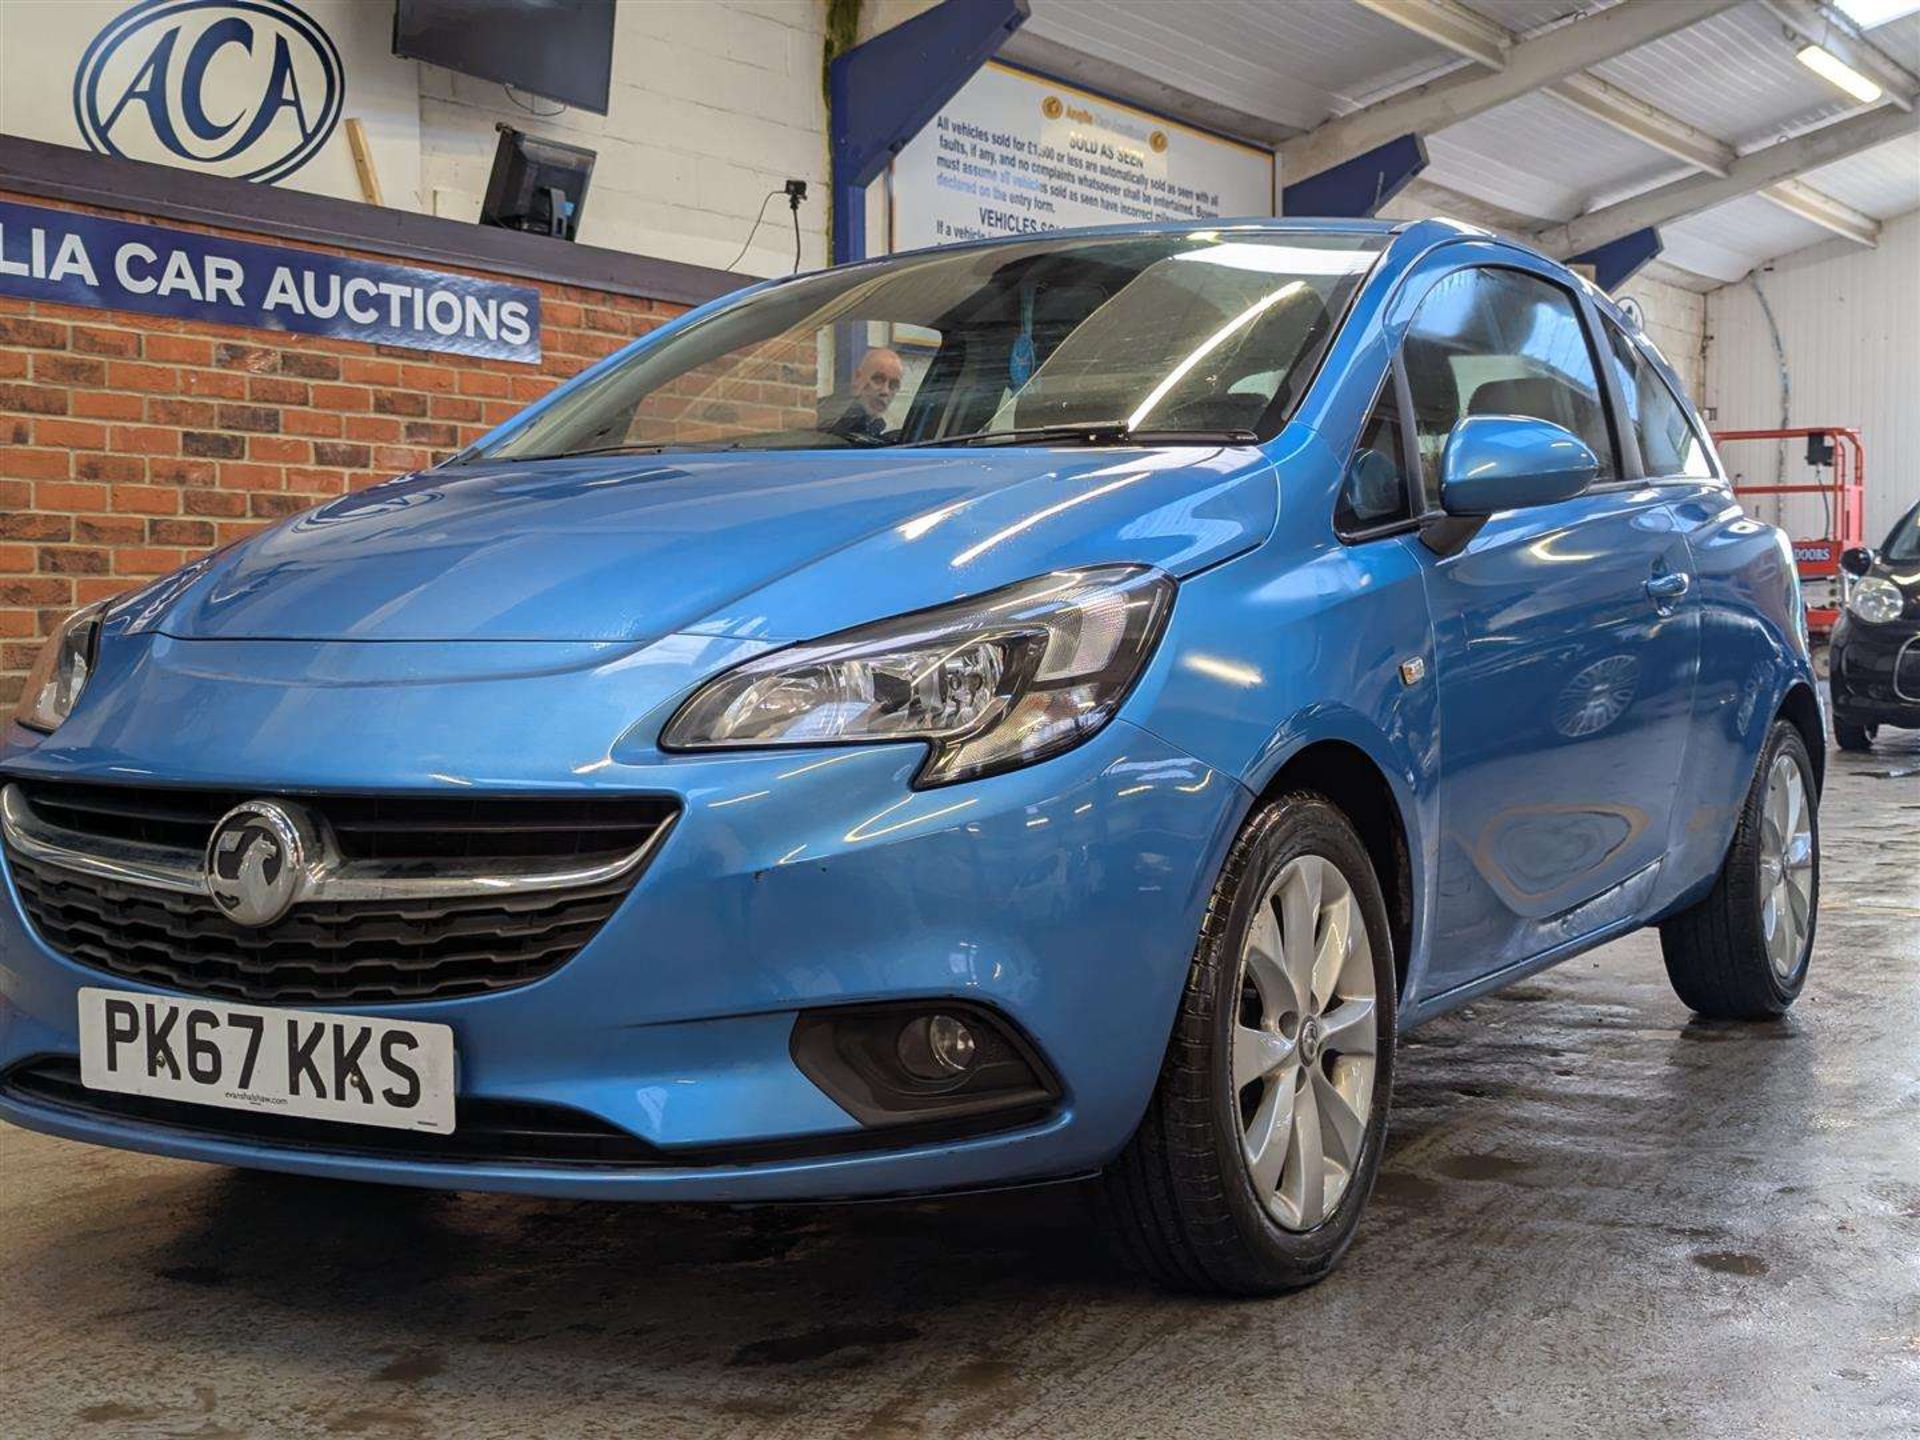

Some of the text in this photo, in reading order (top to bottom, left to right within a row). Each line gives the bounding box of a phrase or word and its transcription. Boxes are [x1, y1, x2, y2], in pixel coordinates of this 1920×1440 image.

[100, 16, 312, 162] ACA
[936, 115, 949, 131] All
[951, 121, 988, 142] vehicles
[991, 133, 1011, 149] sold
[1013, 138, 1025, 152] for
[1056, 151, 1065, 162] or
[1067, 151, 1083, 169] less
[1085, 159, 1098, 173] are
[1099, 163, 1149, 190] automatically
[1150, 178, 1166, 193] sold
[1167, 183, 1176, 196] as
[1178, 185, 1194, 200] seen
[939, 134, 968, 156] faults,
[970, 143, 977, 158] if
[999, 153, 1016, 169] and
[1018, 159, 1029, 172] no
[1031, 162, 1075, 185] complaints
[1077, 174, 1122, 196] whatsoever
[1123, 186, 1141, 203] shall
[1142, 190, 1151, 206] be
[1101, 143, 1114, 161] AS
[936, 155, 960, 172] must
[962, 162, 997, 180] assume
[1012, 174, 1048, 194] vehicles
[1050, 183, 1067, 199] sold
[1069, 190, 1078, 202] as
[1080, 192, 1098, 208] seen
[1100, 196, 1119, 214] have
[1120, 200, 1153, 221] incorrect
[936, 172, 977, 195] declared
[980, 184, 991, 198] on
[992, 186, 1007, 202] the
[1009, 192, 1032, 211] entry
[979, 206, 1037, 233] VEHICLES
[936, 219, 944, 235] If
[945, 224, 951, 237] a
[114, 241, 245, 307] CAR
[262, 266, 533, 346] AUCTIONS
[105, 998, 421, 1109] PK67 KKS
